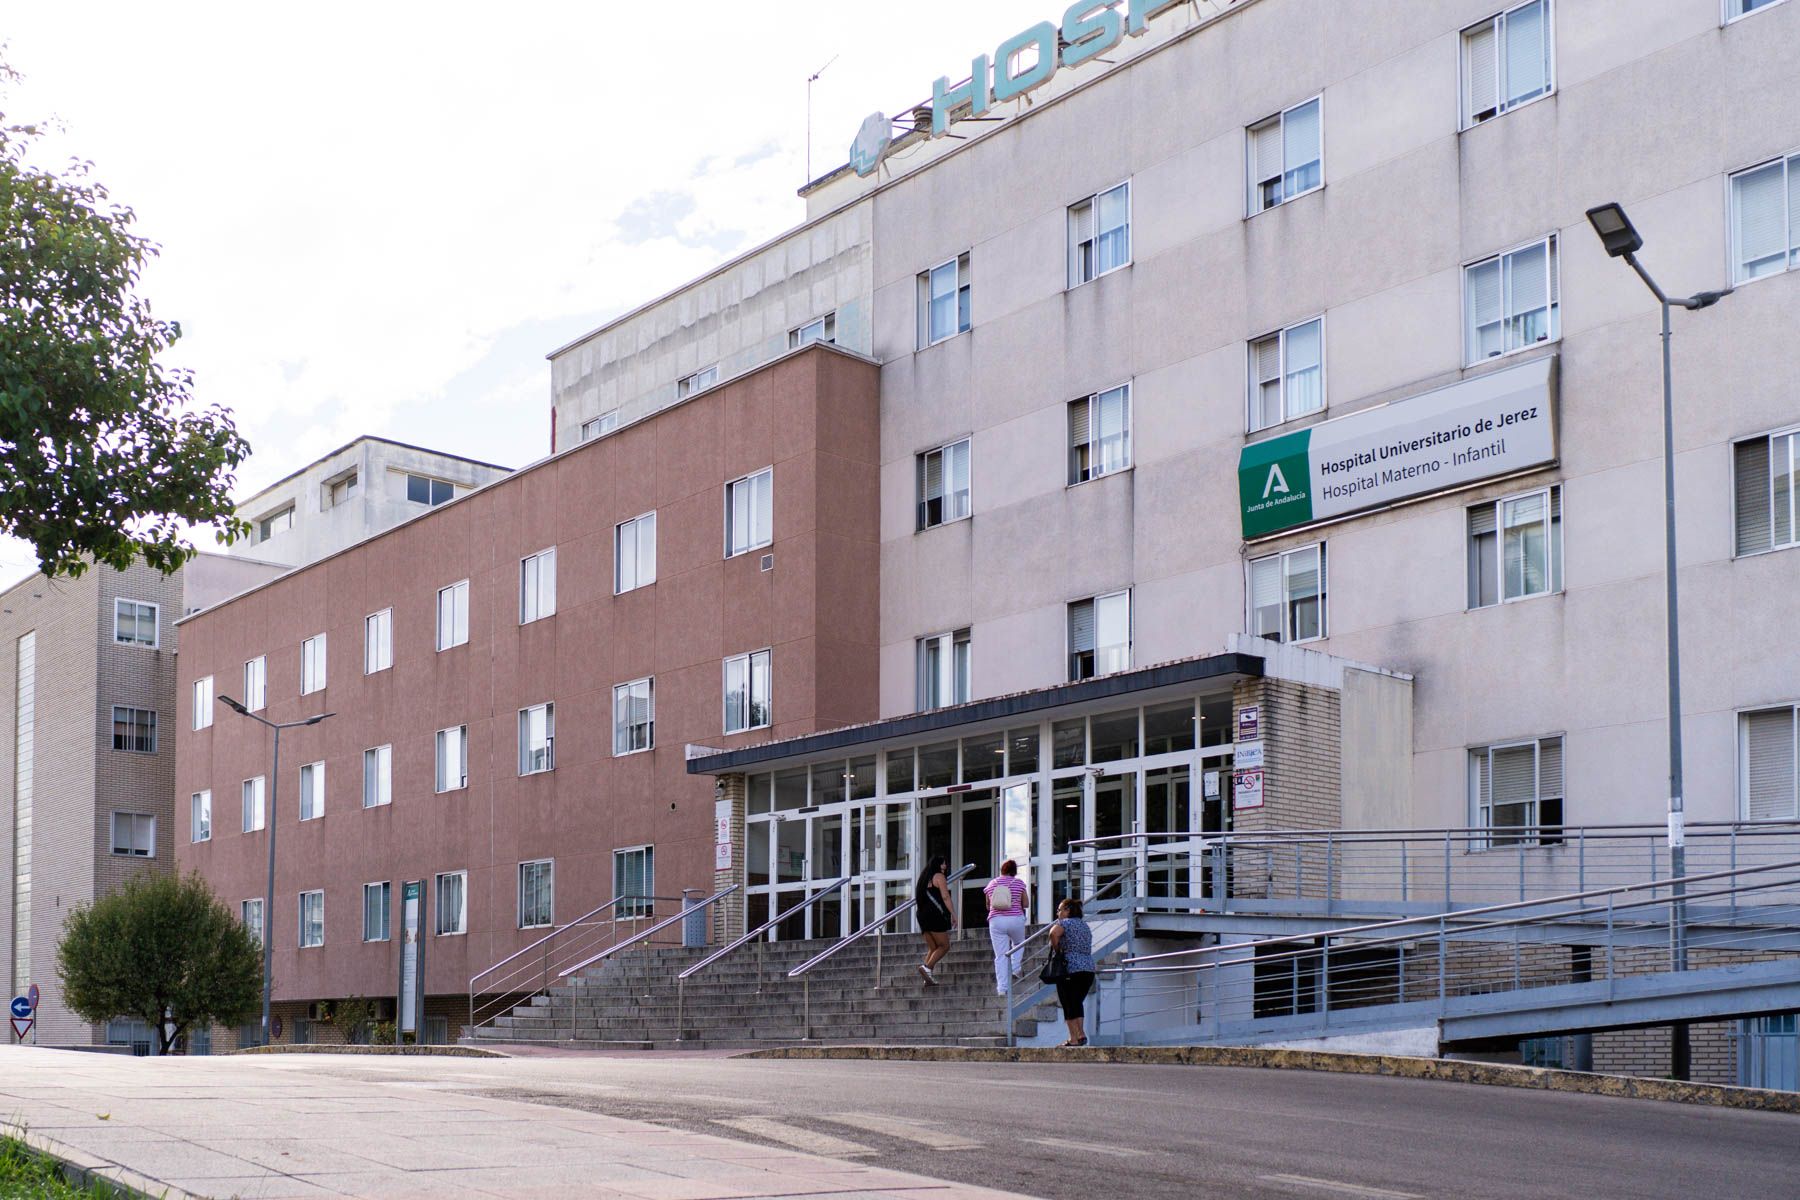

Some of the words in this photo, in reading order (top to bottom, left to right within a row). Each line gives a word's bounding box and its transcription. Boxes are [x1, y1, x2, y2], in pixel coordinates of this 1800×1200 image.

[1321, 448, 1377, 475] Hospital
[1379, 424, 1471, 459] Universitario
[1474, 418, 1493, 434] de
[1496, 407, 1538, 428] Jerez
[1323, 472, 1379, 500] Hospital
[1382, 460, 1441, 485] Materno
[1453, 438, 1506, 466] Infantil
[1247, 503, 1265, 513] Junta
[1265, 500, 1274, 508] de
[1274, 491, 1306, 506] Andalucía
